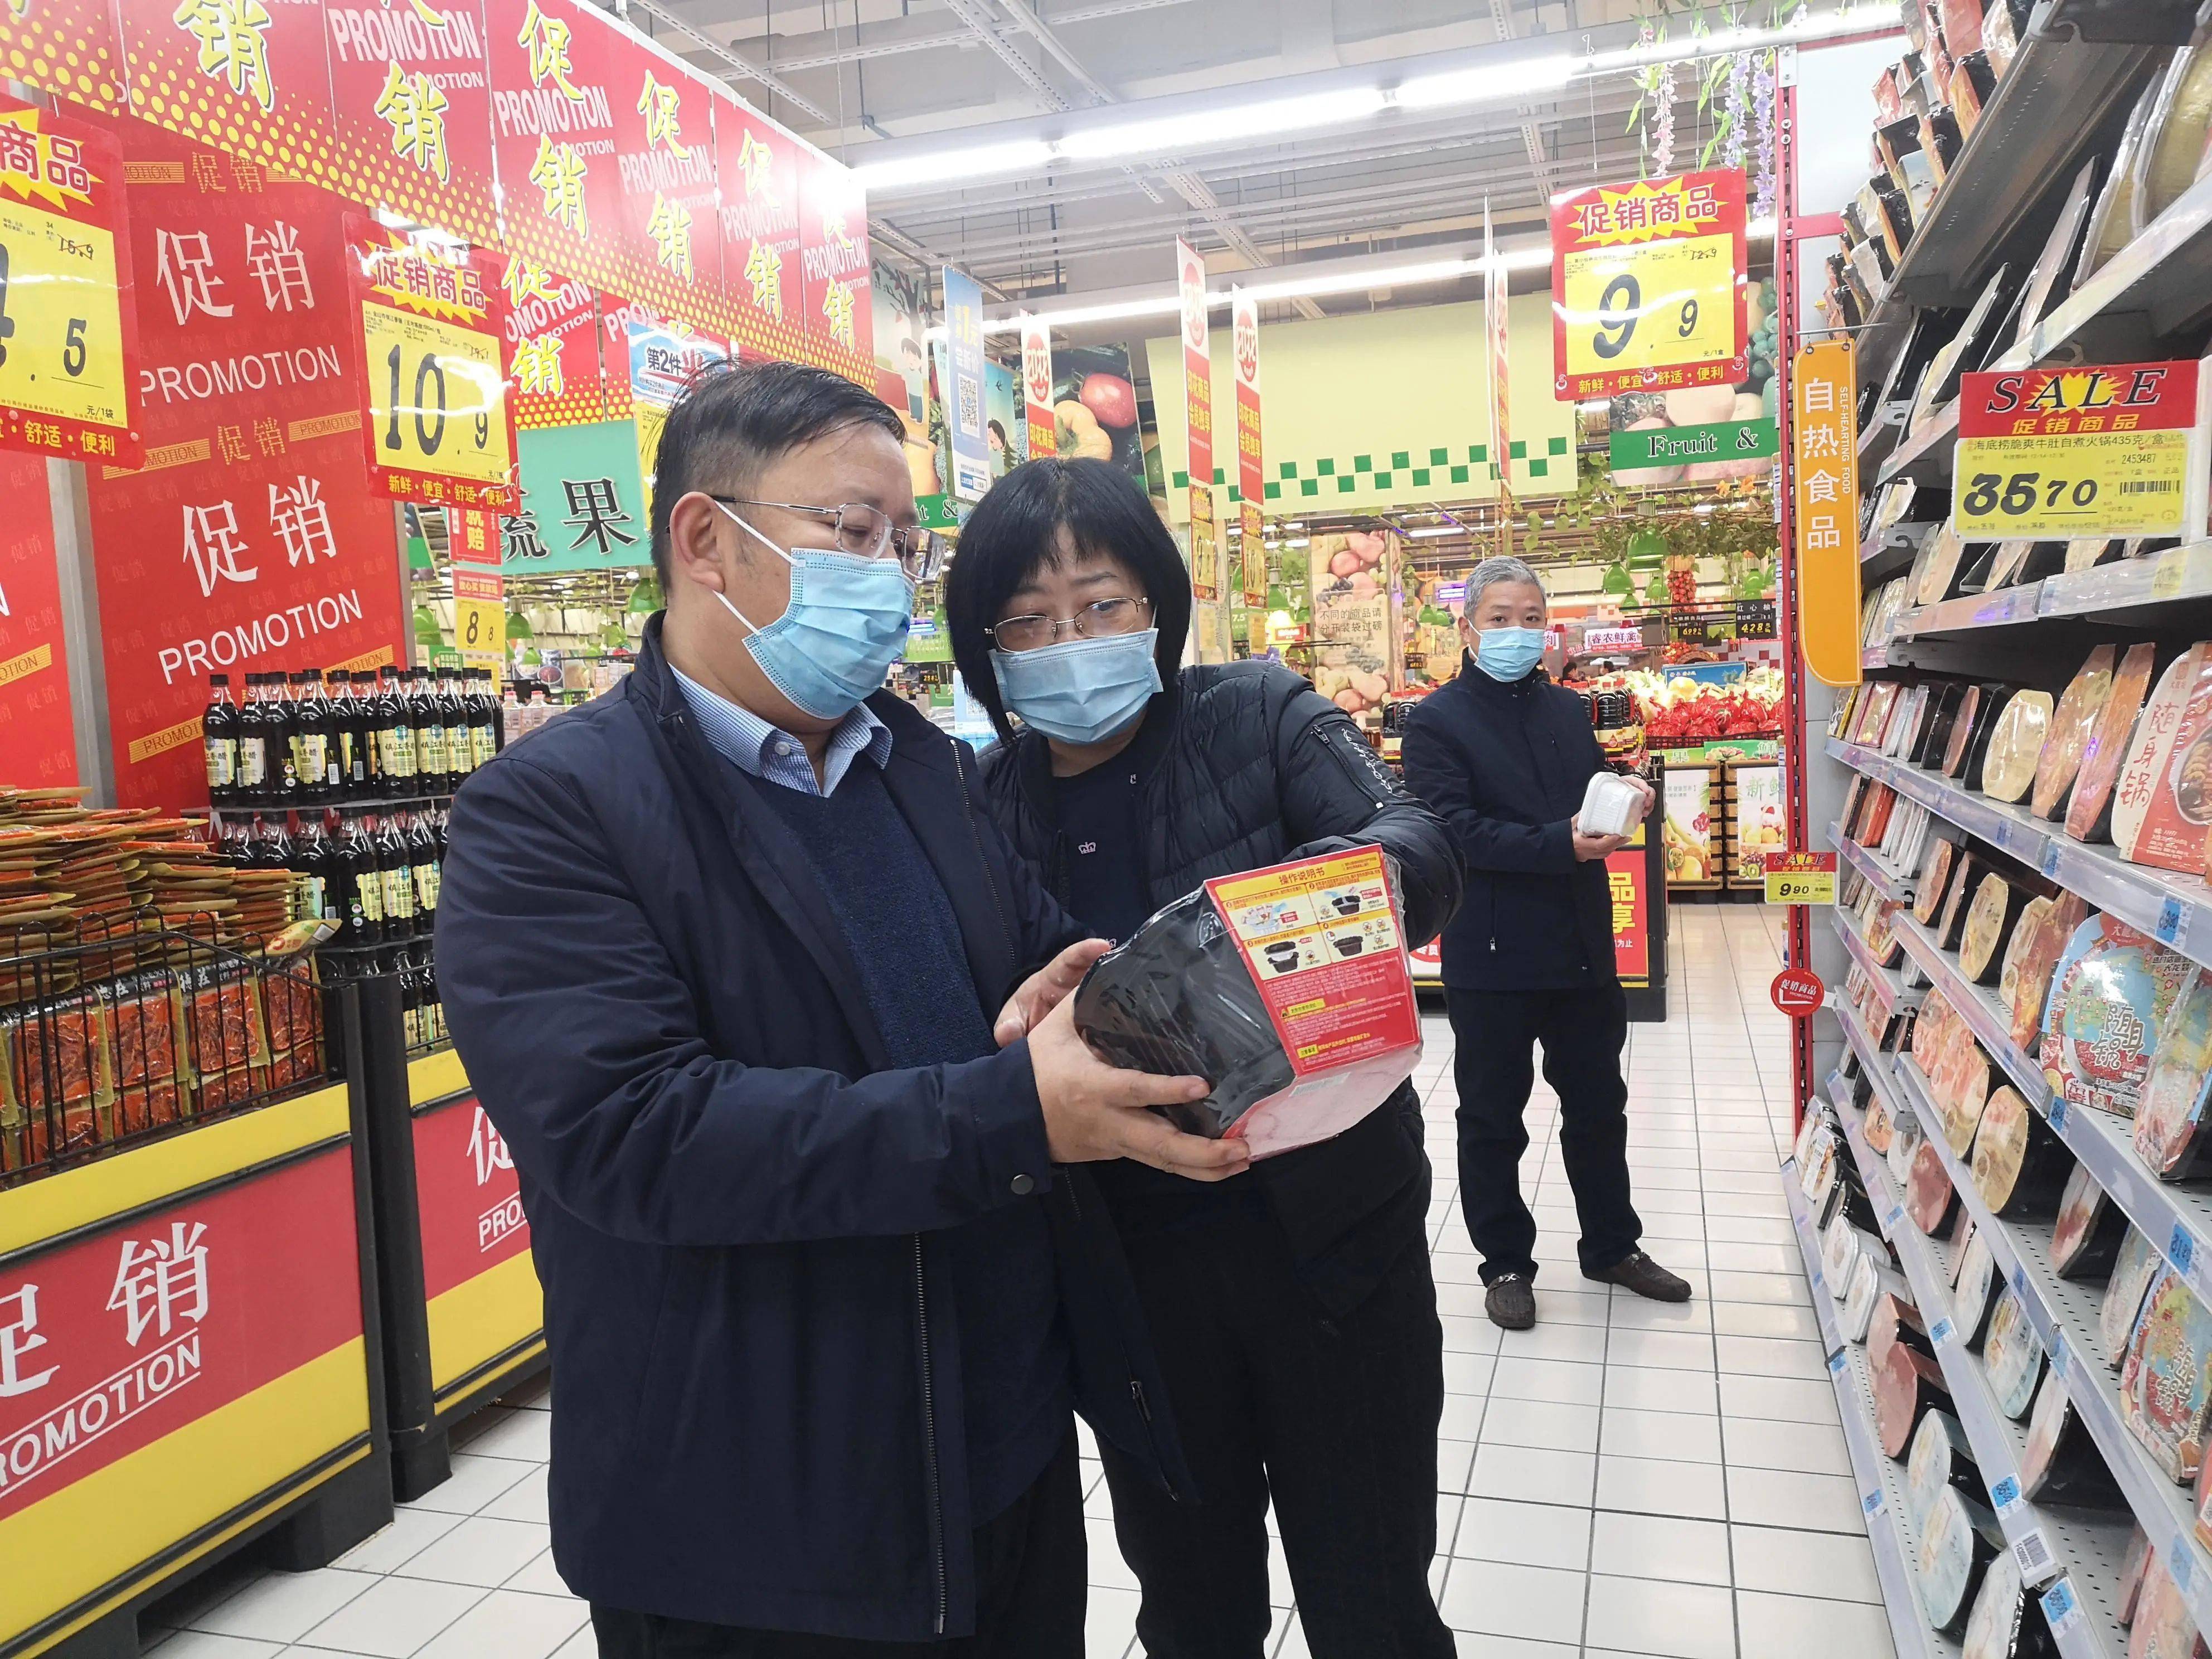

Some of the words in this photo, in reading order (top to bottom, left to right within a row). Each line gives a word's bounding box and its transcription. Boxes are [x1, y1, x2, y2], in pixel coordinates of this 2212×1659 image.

[327, 8, 482, 62] PROMOTION
[493, 85, 613, 138] PROMOTION
[617, 144, 712, 195] PROMOTION
[1579, 185, 1719, 237] 促销商品
[156, 220, 314, 326] 促销
[376, 255, 486, 311] 促销商品
[140, 345, 341, 407] PROMOTION
[1986, 368, 2167, 414] SALE
[217, 417, 286, 465] 促销
[1648, 431, 1718, 459] Fruit
[1736, 426, 1758, 450] &
[2012, 414, 2140, 435] 促销商品
[1802, 377, 1840, 550] 自热食品
[1842, 467, 1851, 494] FOOD
[183, 476, 337, 598] 促销
[158, 589, 363, 685] PROMOTION
[466, 611, 478, 644] 8
[2121, 702, 2180, 808] 随身锅
